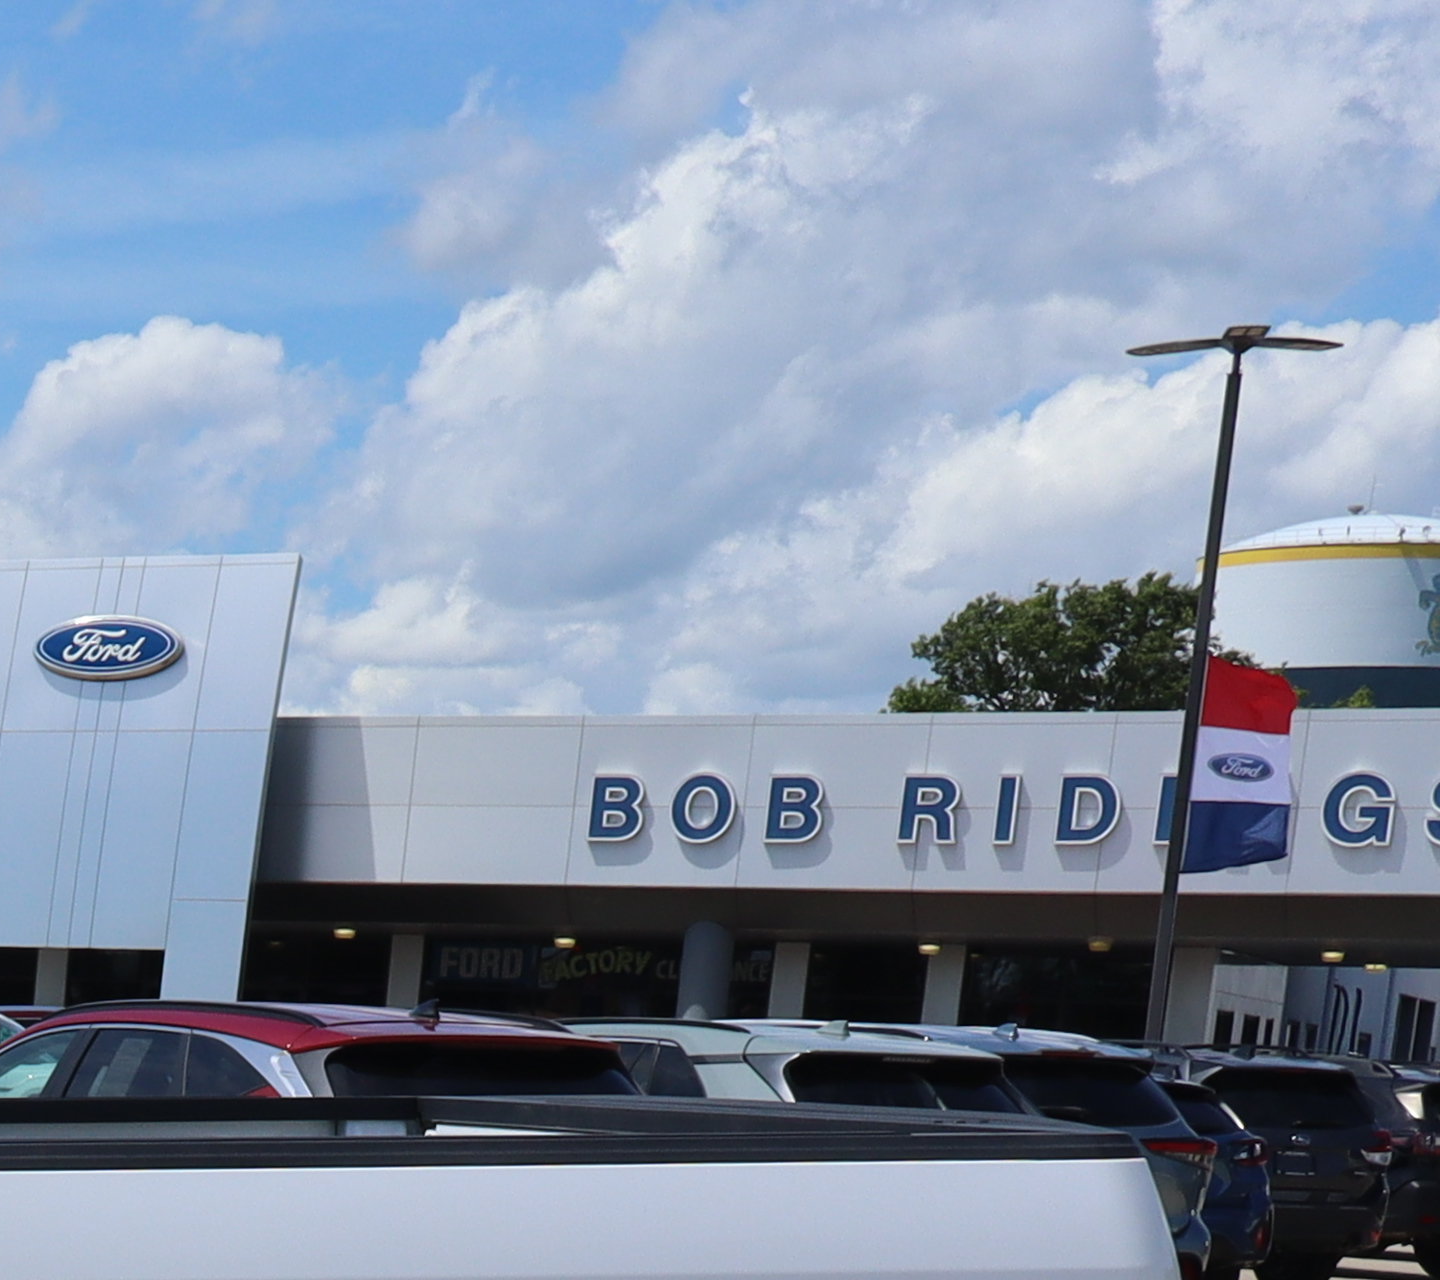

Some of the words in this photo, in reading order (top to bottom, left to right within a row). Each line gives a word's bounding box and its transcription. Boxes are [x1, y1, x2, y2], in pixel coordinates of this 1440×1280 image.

[62, 628, 146, 662] Ford
[1220, 756, 1266, 779] Ford
[587, 771, 824, 844] BOB
[896, 770, 1440, 847] RIDIG
[438, 946, 525, 980] FORD
